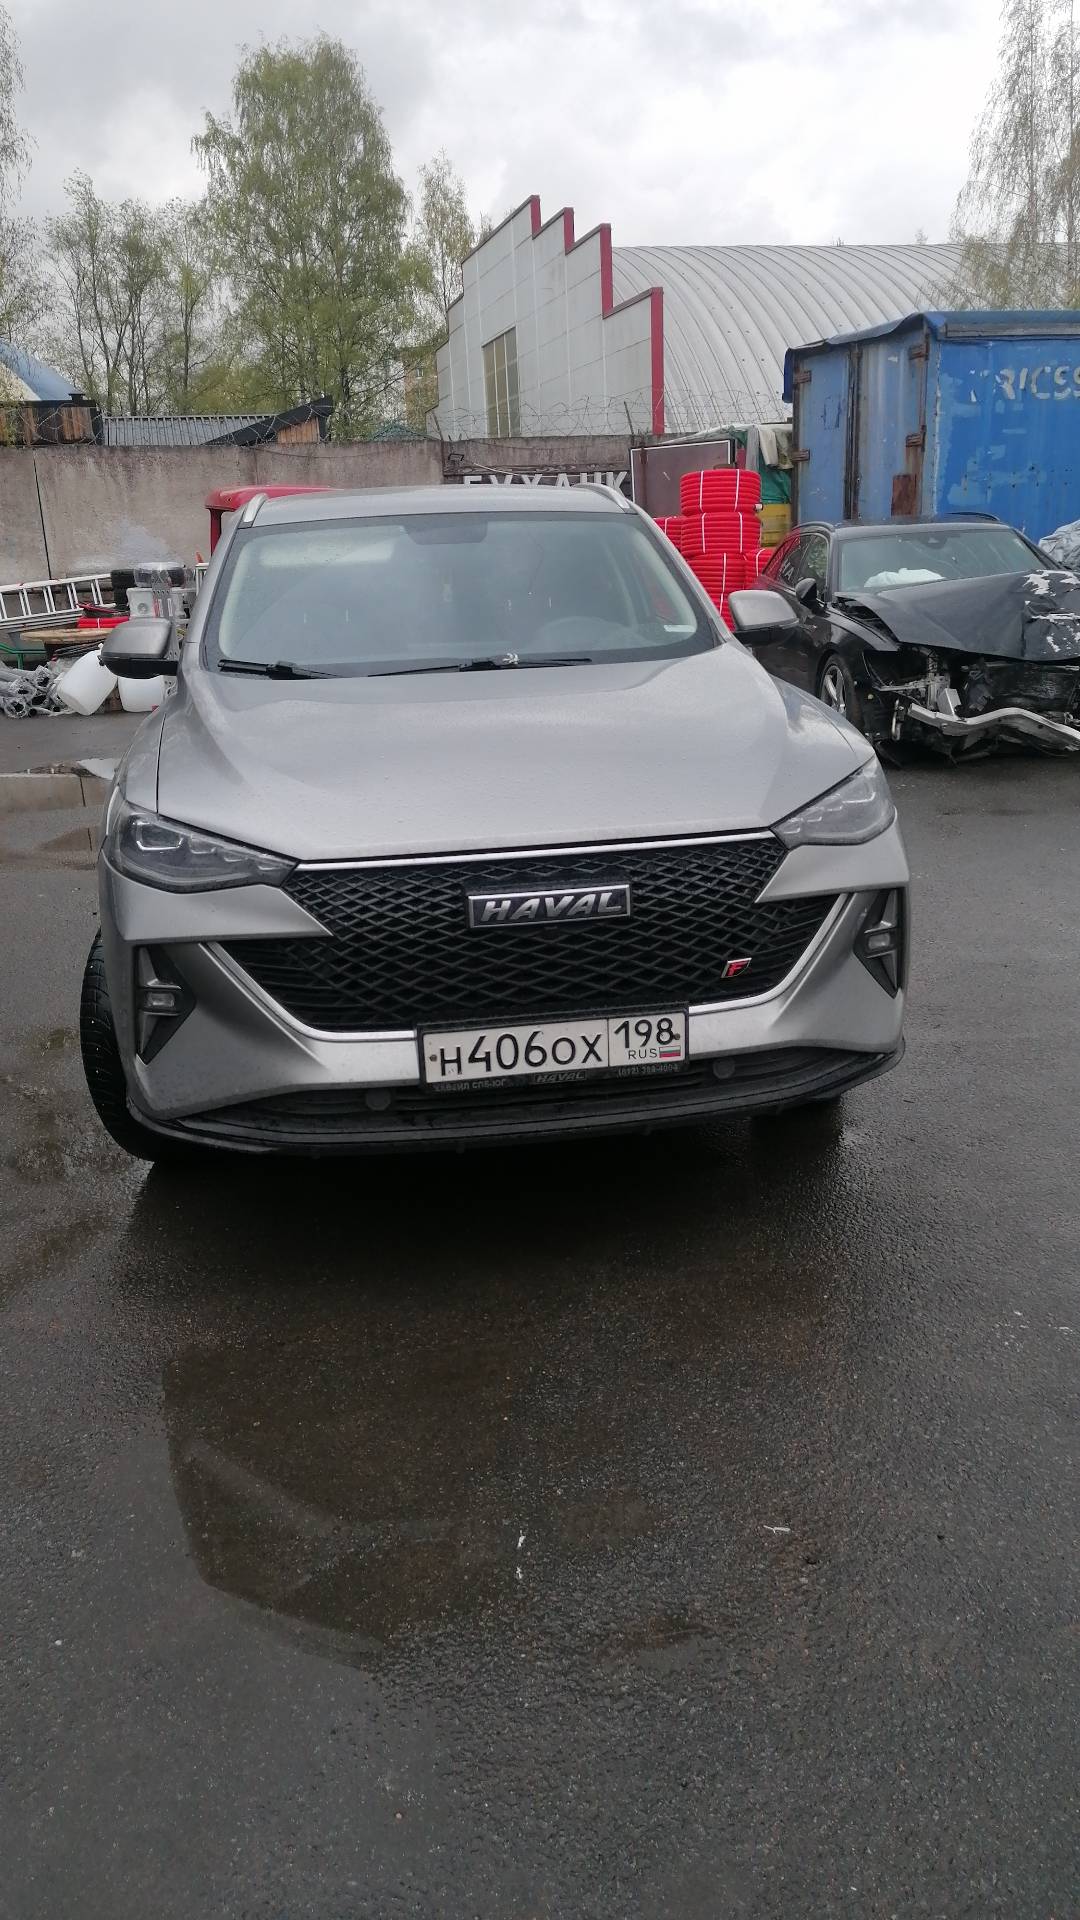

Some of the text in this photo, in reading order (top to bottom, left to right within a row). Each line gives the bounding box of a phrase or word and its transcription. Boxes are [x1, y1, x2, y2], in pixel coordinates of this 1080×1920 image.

[481, 892, 622, 922] HAVAL
[440, 1018, 673, 1076] Н406ОХ 198
[628, 1048, 657, 1060] RUS
